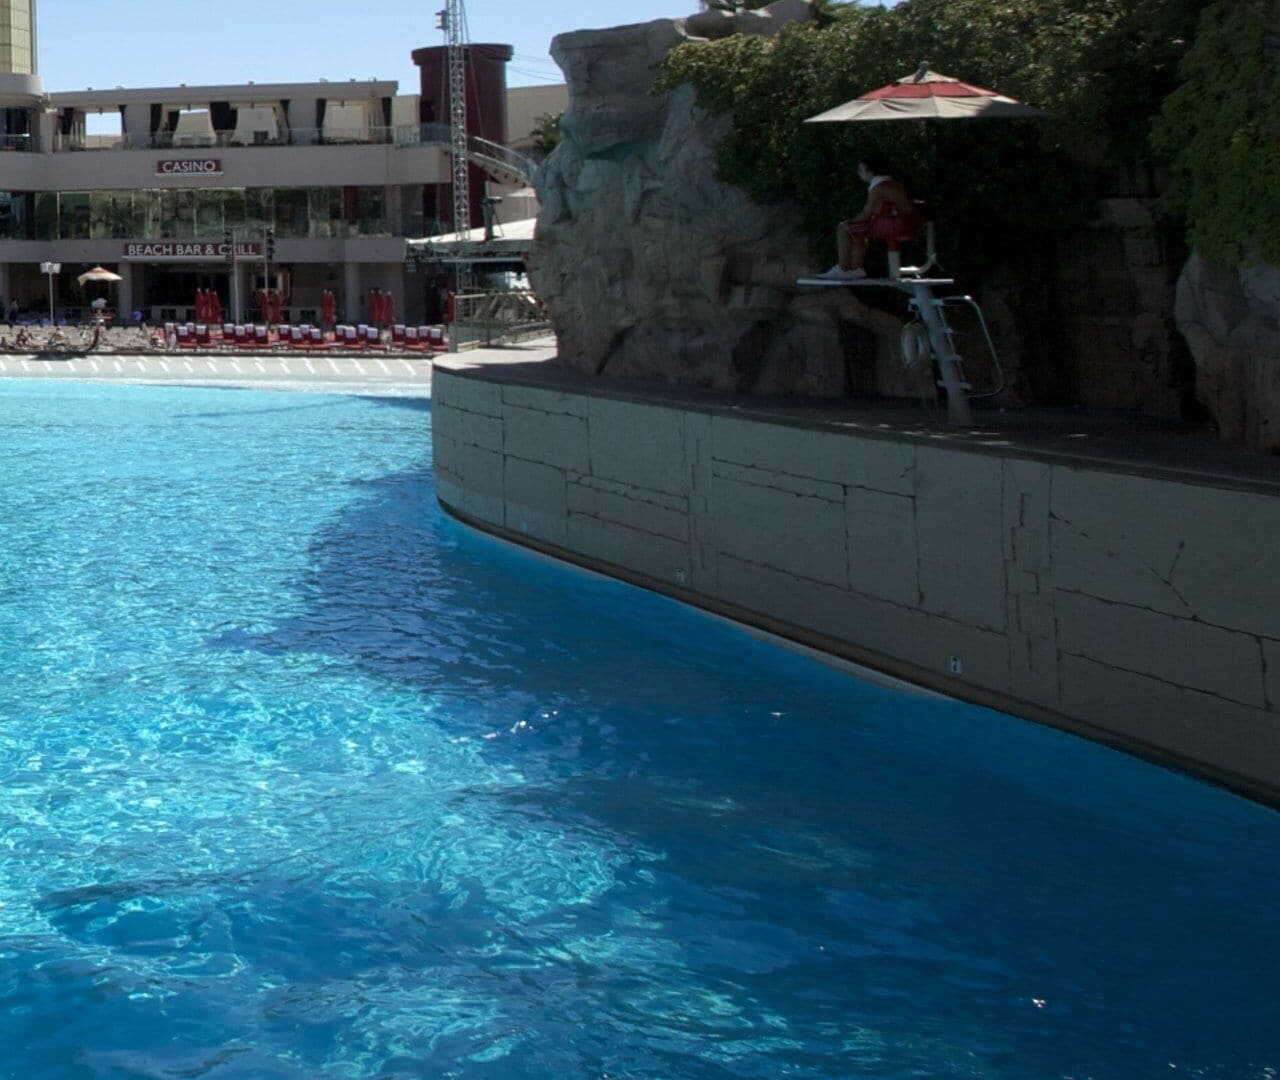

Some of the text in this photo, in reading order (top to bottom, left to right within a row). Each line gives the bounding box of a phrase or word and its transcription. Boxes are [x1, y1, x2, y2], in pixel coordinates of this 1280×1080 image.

[162, 160, 216, 172] CASINO
[128, 244, 172, 256] BEACH
[175, 244, 202, 256] BAR
[205, 244, 215, 256] &
